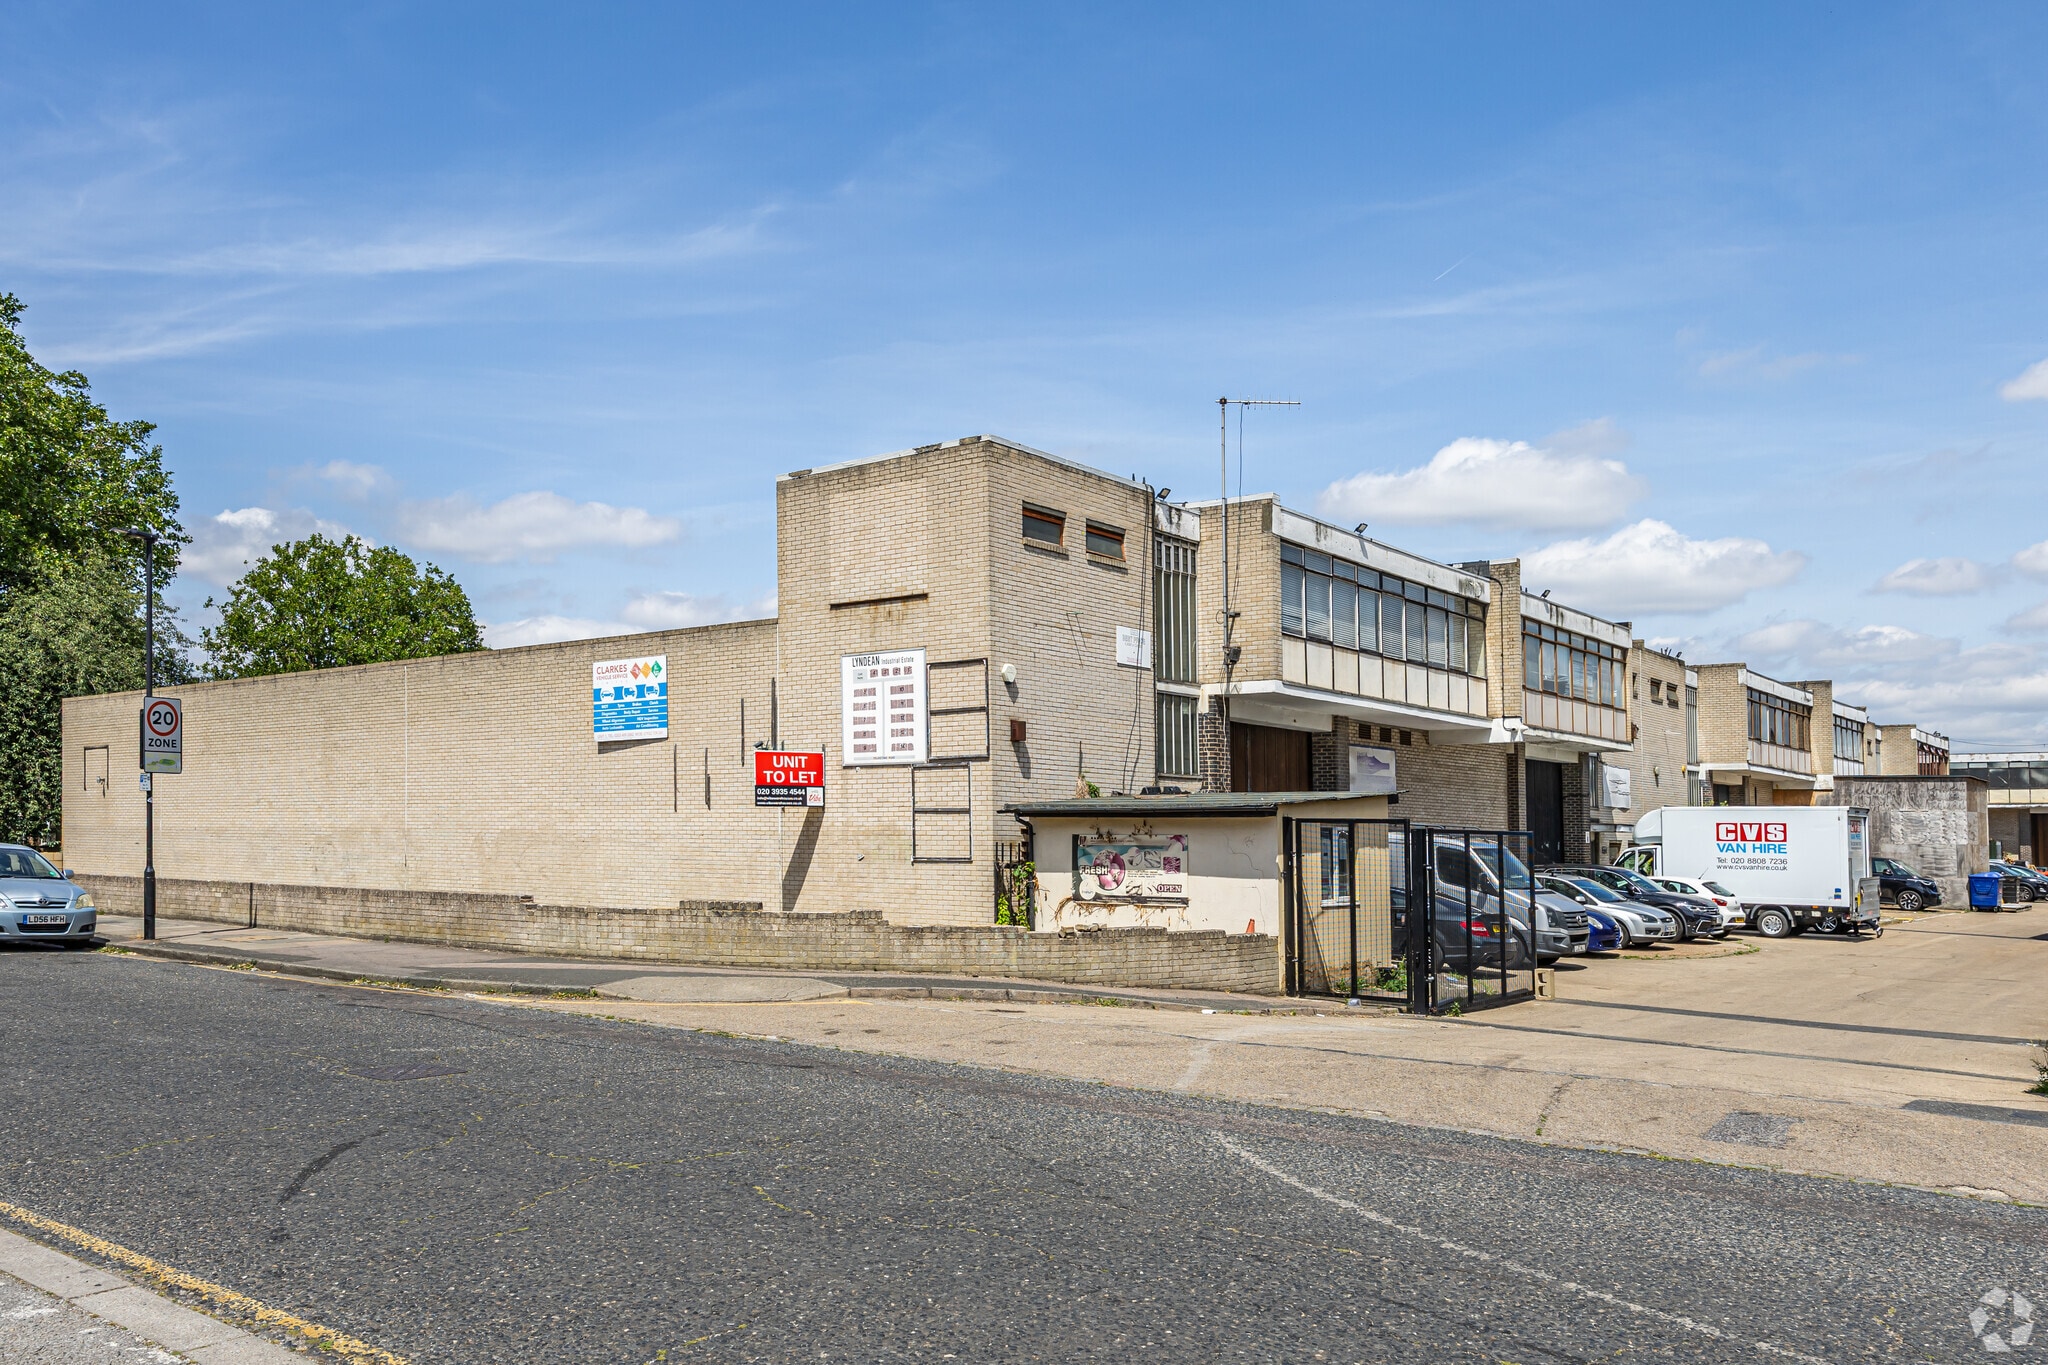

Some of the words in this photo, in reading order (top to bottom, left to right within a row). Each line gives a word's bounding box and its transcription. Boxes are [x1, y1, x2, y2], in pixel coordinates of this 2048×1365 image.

[852, 655, 880, 668] LYNDEAN
[596, 664, 628, 675] CLARKES
[152, 710, 174, 725] 20
[148, 738, 177, 748] ZONE
[772, 756, 808, 768] UNIT
[763, 770, 785, 783] TO
[790, 771, 817, 784] LET
[1718, 823, 1785, 841] CVS
[1716, 843, 1746, 853] VAN
[1752, 843, 1787, 854] HIRE
[1079, 865, 1108, 875] FRESH
[1157, 884, 1182, 893] OPEN
